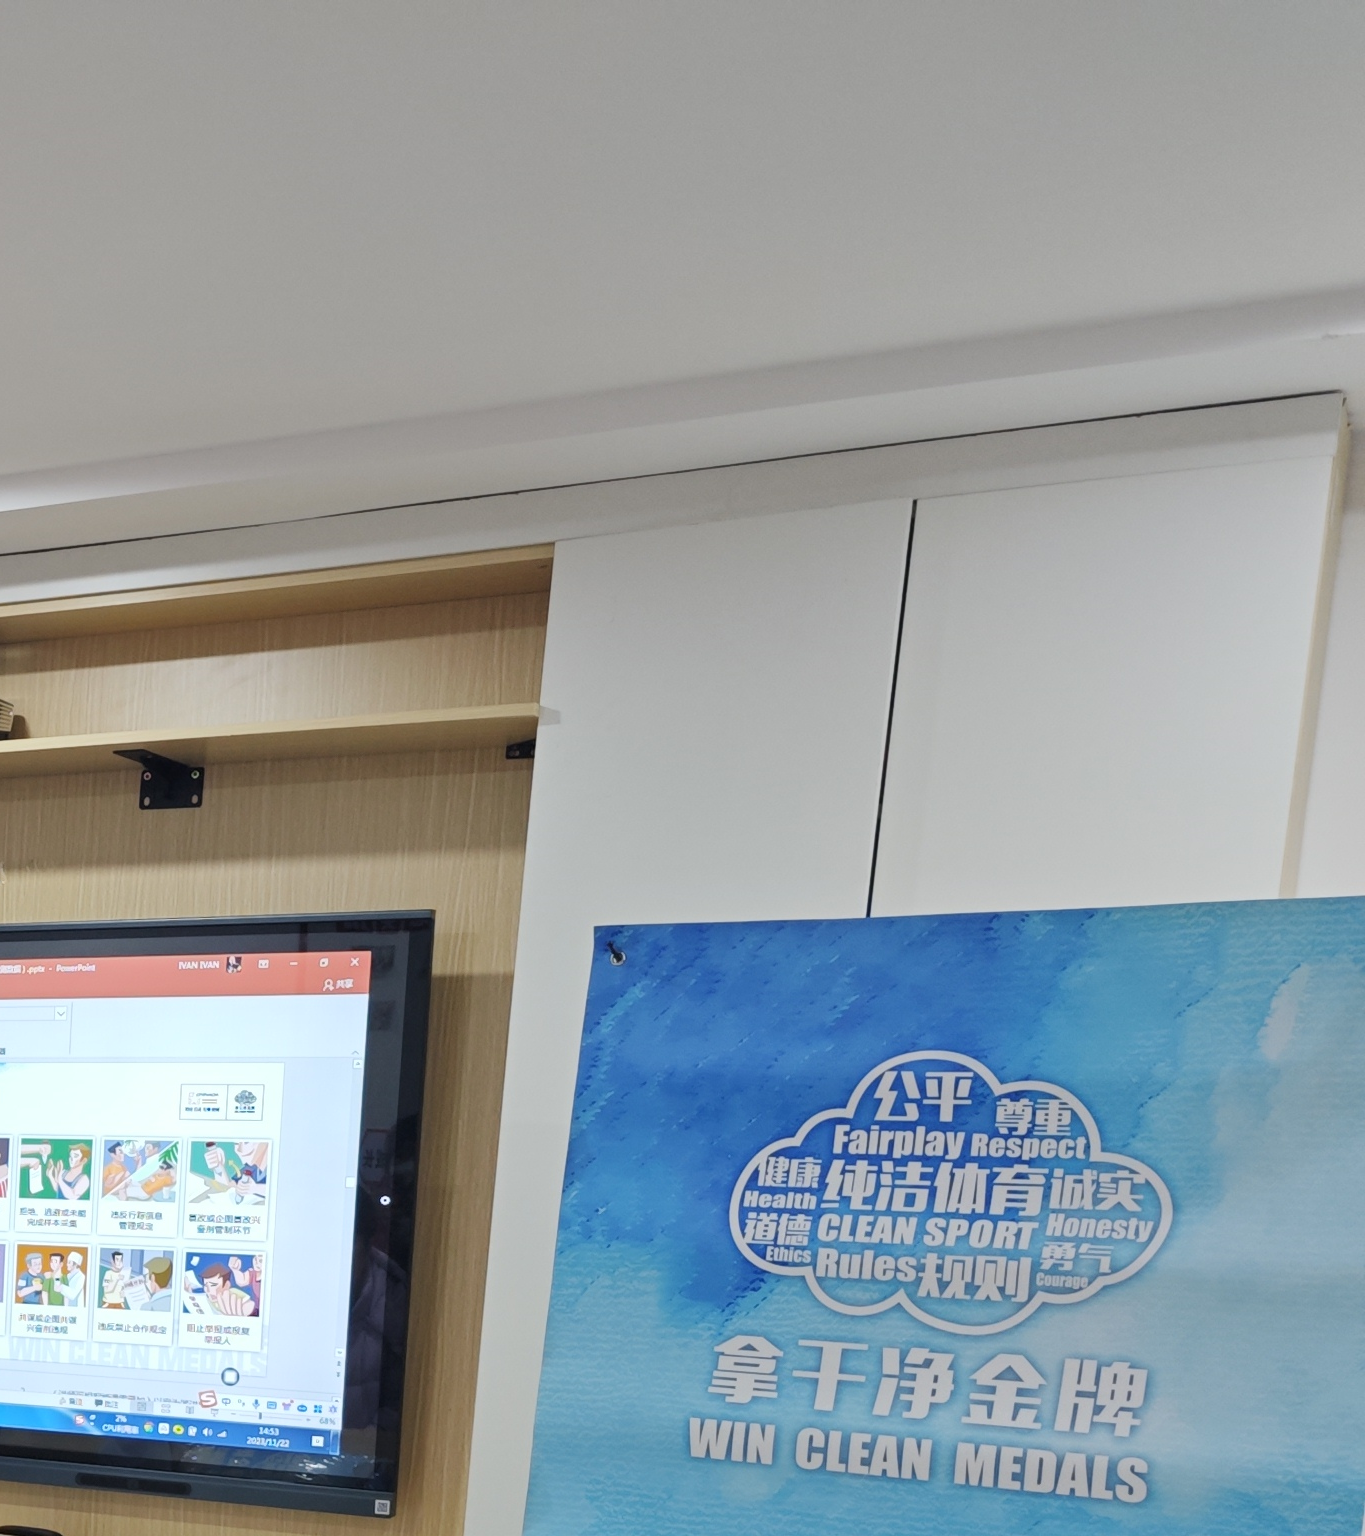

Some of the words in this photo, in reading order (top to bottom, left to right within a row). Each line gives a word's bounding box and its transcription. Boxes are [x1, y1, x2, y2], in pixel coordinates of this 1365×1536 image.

[178, 961, 198, 970] IVAN
[199, 960, 219, 969] IVAN
[874, 1069, 975, 1122] 公平
[995, 1098, 1073, 1137] 尊重
[833, 1124, 966, 1160] Fairplay
[970, 1133, 1087, 1161] Respect
[757, 1155, 822, 1188] 健康
[821, 1158, 1050, 1217] 纯洁体育
[743, 1190, 818, 1210] Health
[1049, 1168, 1148, 1212] 诚实
[743, 1211, 813, 1247] 道德
[817, 1214, 917, 1246] CLEAN
[923, 1217, 1040, 1251] SPORT
[1044, 1213, 1154, 1243] Honesty
[766, 1244, 812, 1264] Ethics
[1039, 1241, 1114, 1273] 勇气
[816, 1247, 917, 1282] Rules
[917, 1251, 1032, 1303] 规则
[1036, 1271, 1090, 1290] Courage
[12, 1337, 61, 1364] WIN
[66, 1341, 155, 1369] CLEAN
[707, 1335, 1149, 1438] 拿干净金牌
[246, 1437, 290, 1448] 2023/11/22
[259, 1427, 279, 1436] 14:53
[688, 1417, 776, 1465] WIN
[795, 1427, 933, 1482] CLEAN
[954, 1442, 1150, 1504] MEDALS
